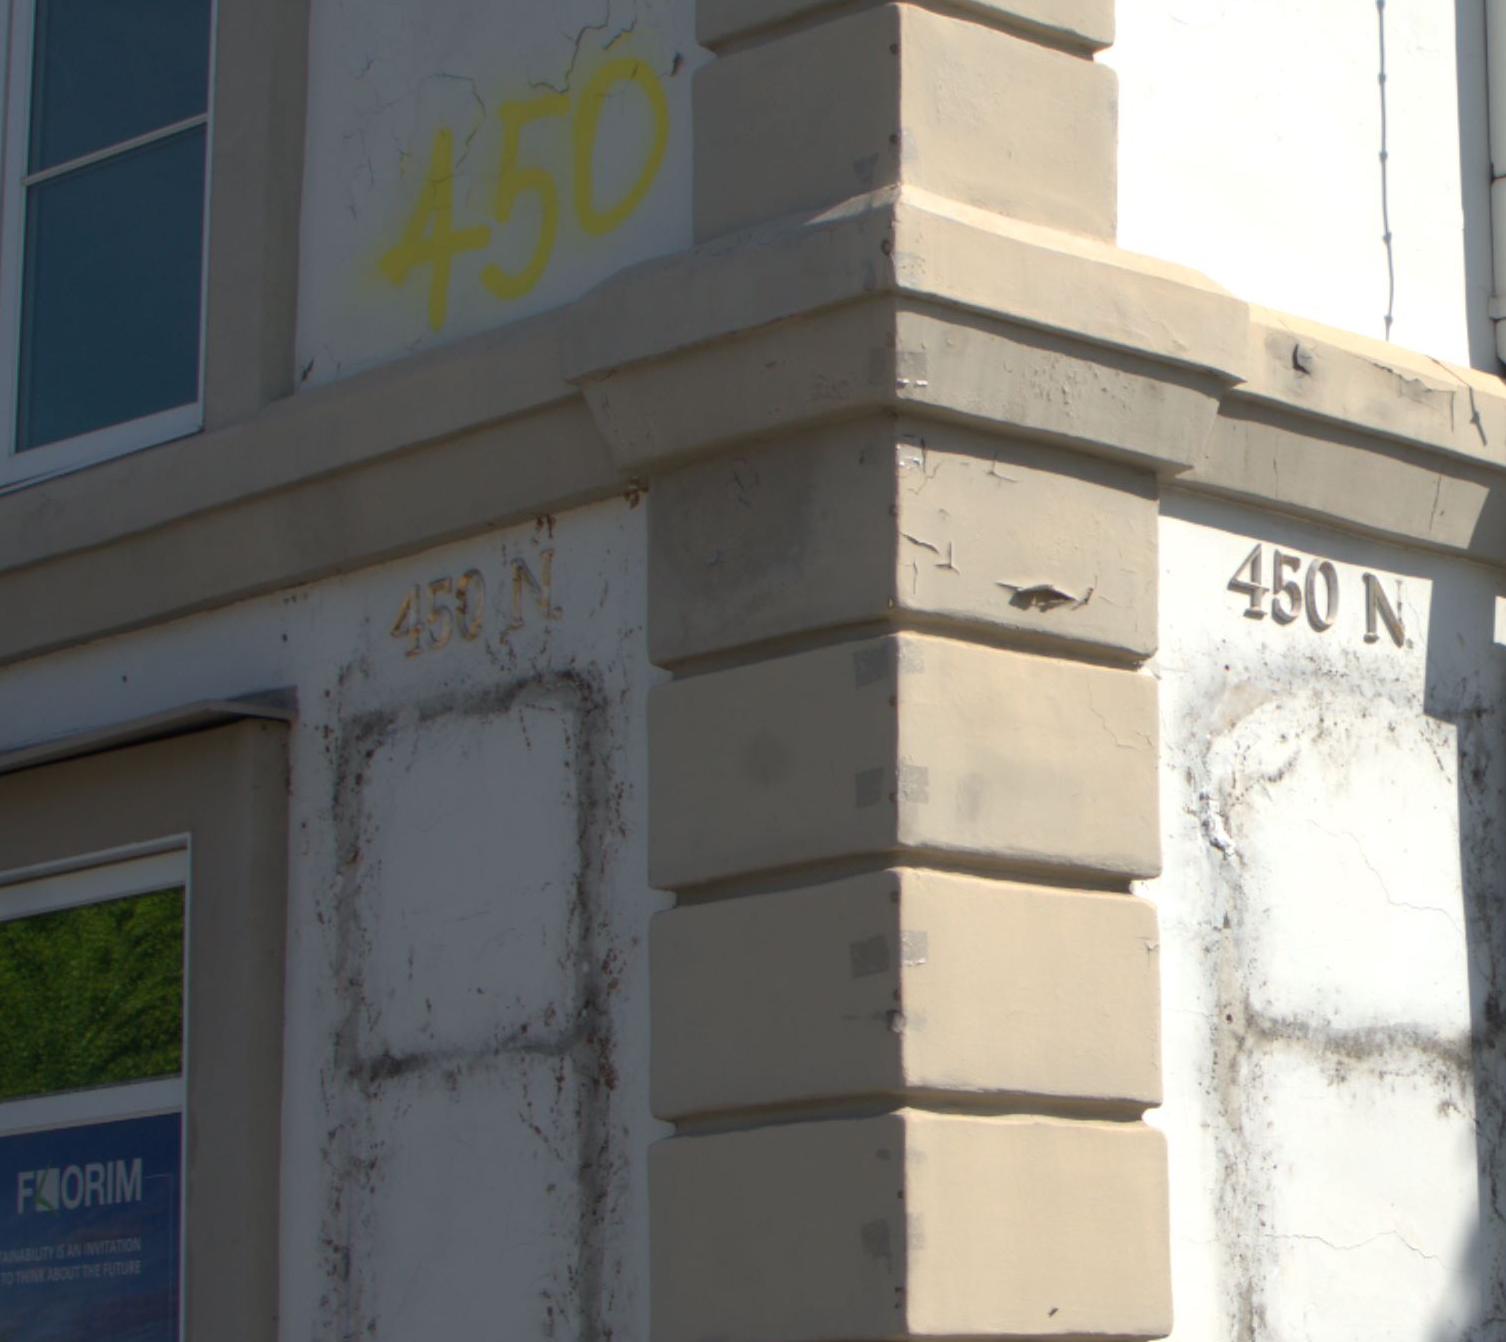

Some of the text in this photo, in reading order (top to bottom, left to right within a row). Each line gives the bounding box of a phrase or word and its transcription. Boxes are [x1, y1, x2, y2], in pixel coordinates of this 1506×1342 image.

[379, 57, 670, 332] 450
[390, 568, 487, 659] 450
[1227, 543, 1339, 633] 450
[0, 1260, 142, 1285] TO THINK ABOUT THE FUTURE
[56, 1244, 65, 1259] IS
[66, 1243, 81, 1257] AN
[84, 1237, 142, 1256] INVITATION
